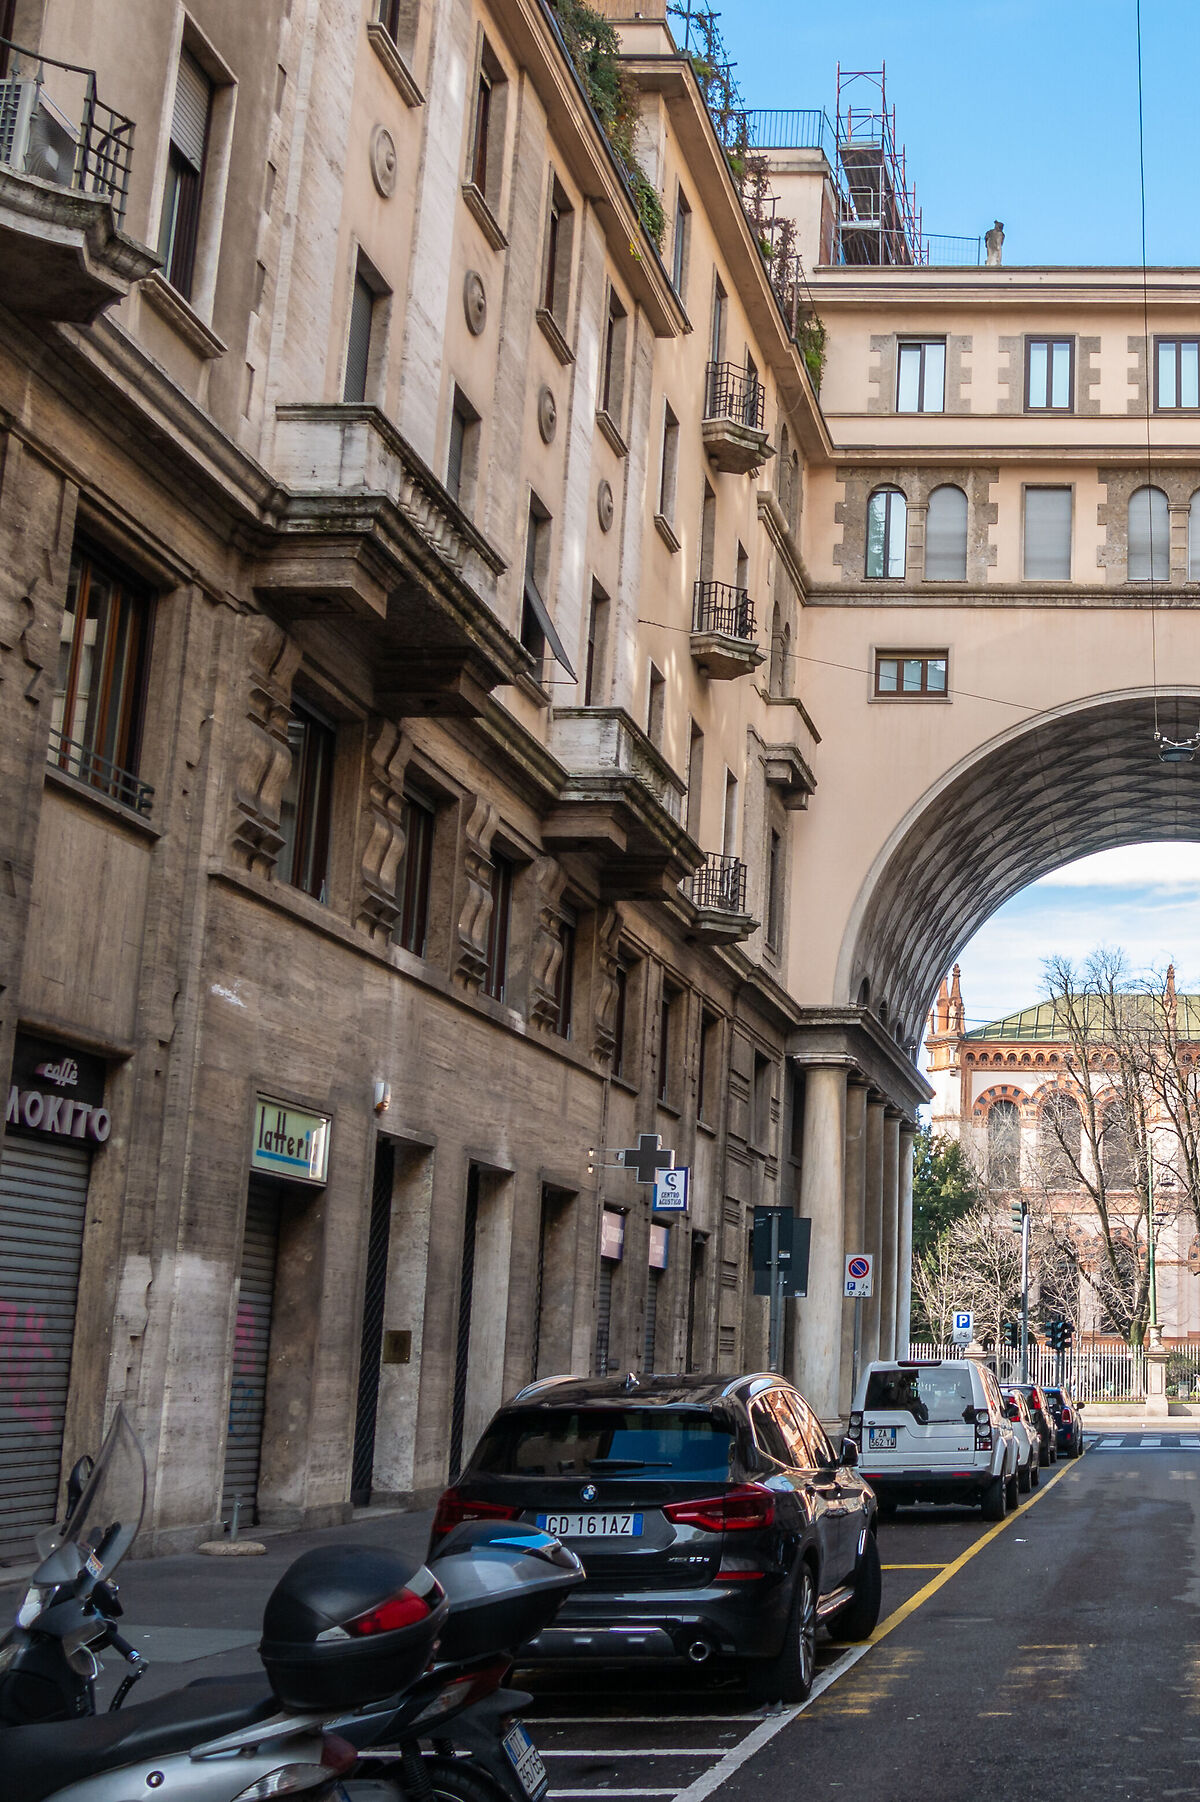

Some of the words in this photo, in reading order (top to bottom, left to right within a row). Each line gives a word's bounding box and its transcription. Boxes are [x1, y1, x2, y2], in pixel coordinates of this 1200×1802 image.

[661, 1191, 680, 1199] CENTRO
[878, 1429, 887, 1438] ZA
[548, 1516, 569, 1536] GD
[578, 1515, 631, 1534] 161AZ
